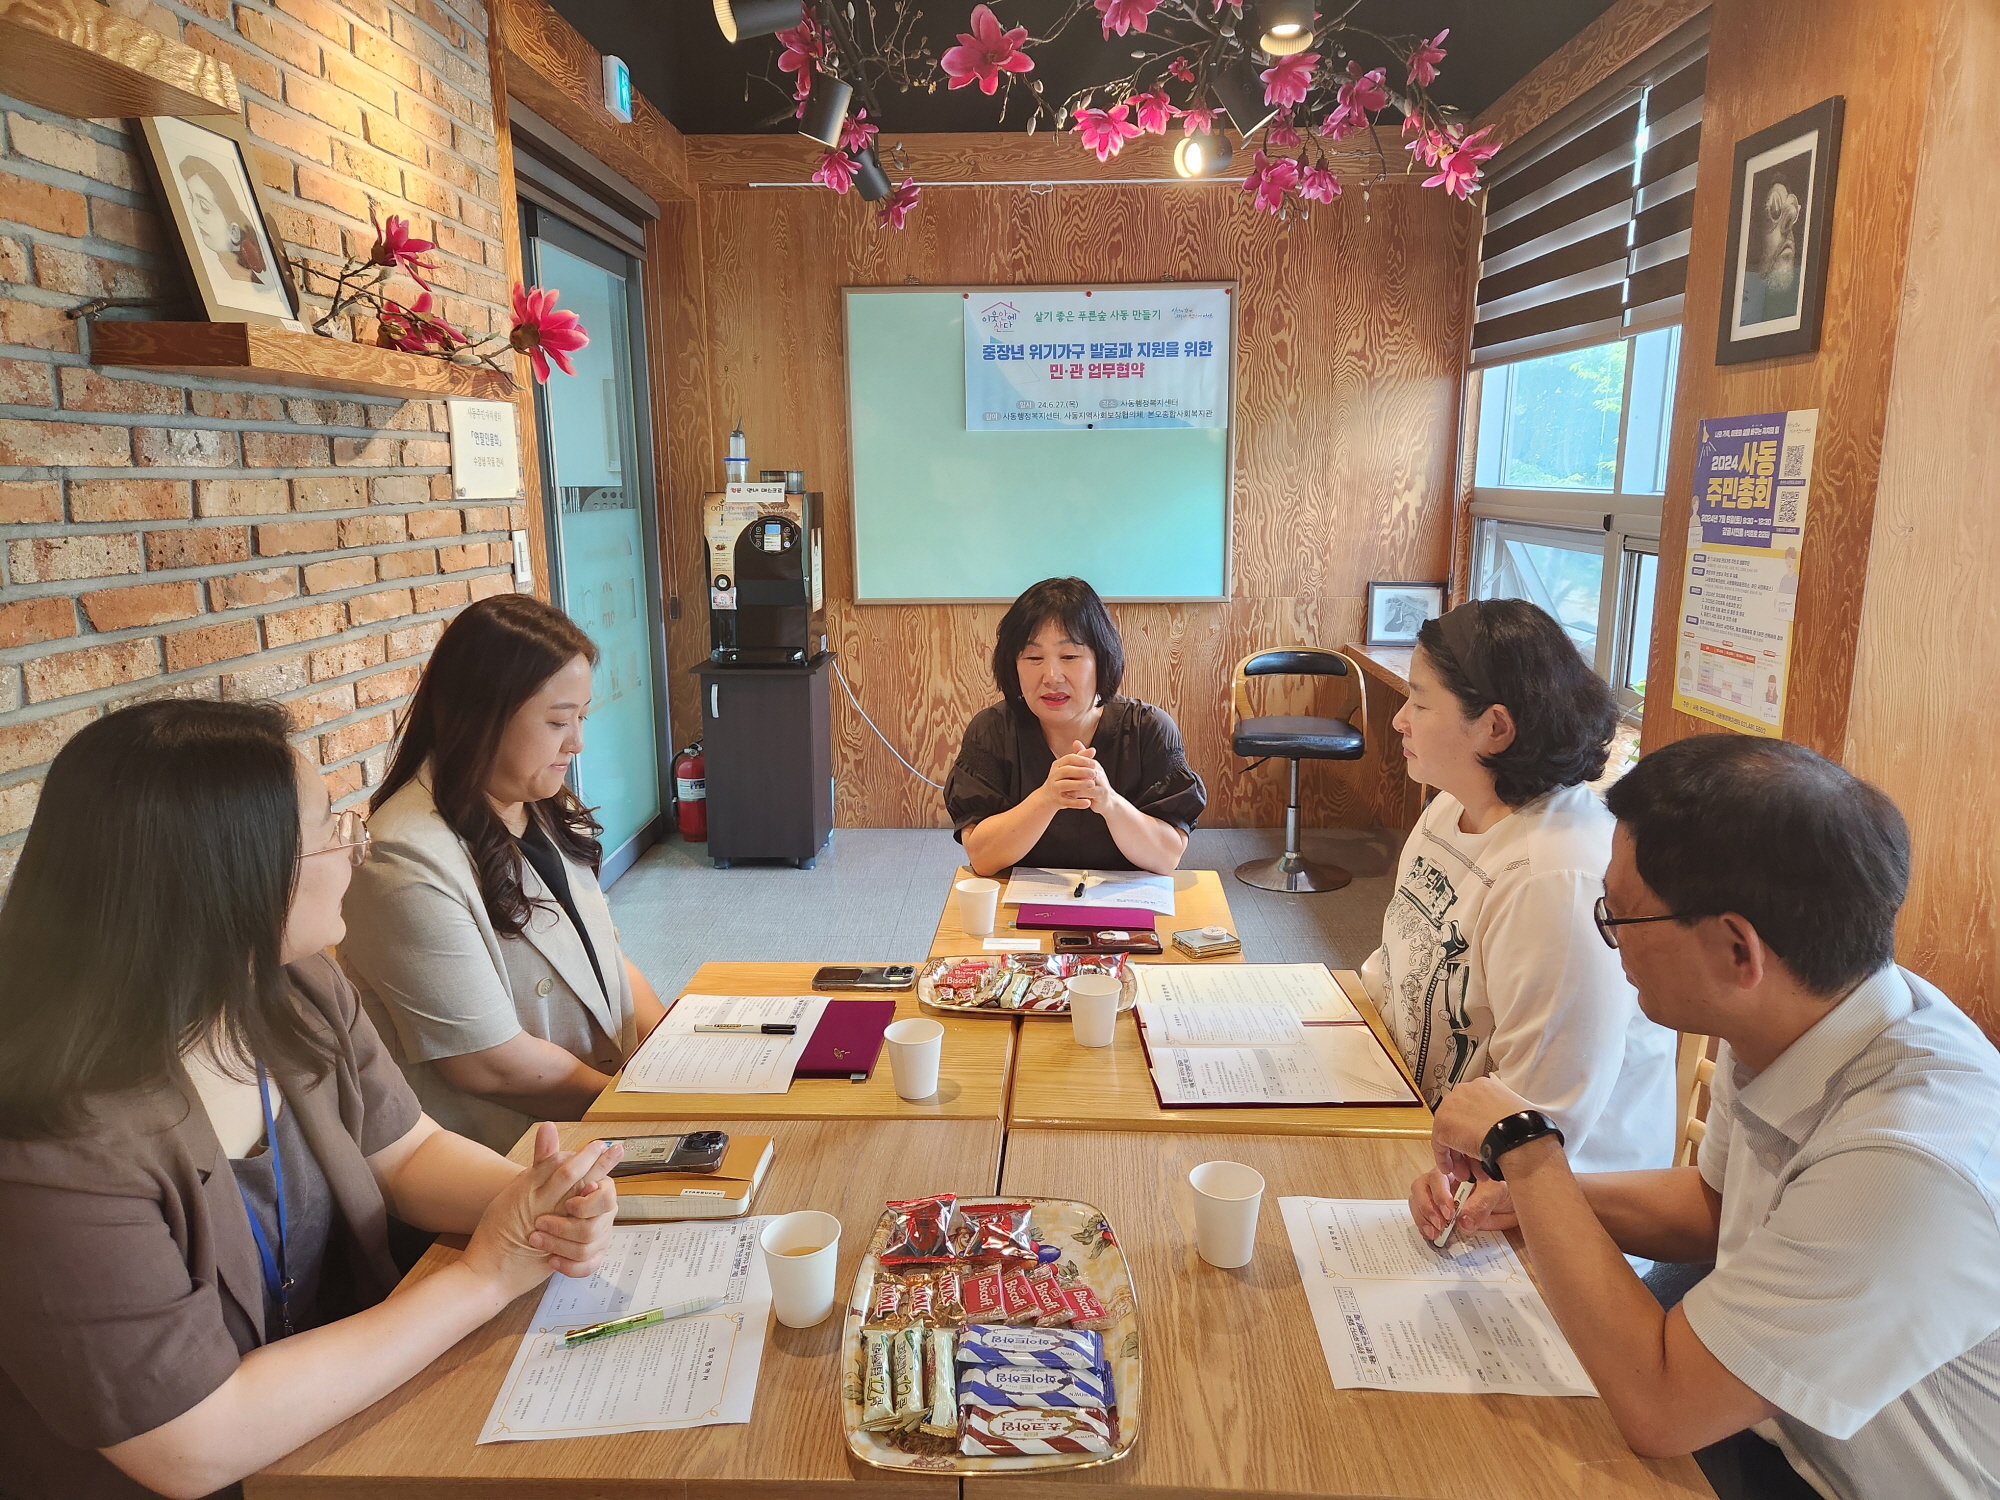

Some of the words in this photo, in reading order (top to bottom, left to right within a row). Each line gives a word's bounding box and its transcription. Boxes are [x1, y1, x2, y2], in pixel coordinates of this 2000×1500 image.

[981, 310, 1017, 323] 이웃안에
[1034, 310, 1053, 322] 살기
[1056, 310, 1075, 322] 좋은
[1077, 309, 1106, 322] 푸른숲
[1110, 309, 1130, 321] 사동
[1132, 308, 1161, 320] 만들기
[993, 321, 1013, 333] 산다
[982, 344, 1025, 360] 중장년
[1029, 343, 1086, 360] 위기가구
[1090, 342, 1133, 359] 발굴과
[1136, 341, 1180, 358] 지원을
[1183, 340, 1213, 357] 위한
[1049, 363, 1084, 380] 민·관
[1088, 362, 1145, 379] 업무협약
[1037, 400, 1079, 409] 24.6.27.(목)
[1120, 399, 1179, 408] 사동행정복지센터
[1147, 410, 1213, 418] 본오종합사회복지관
[1711, 455, 1738, 471] 2024
[1738, 440, 1777, 475] 사동
[1706, 476, 1772, 509] 주민총회
[1701, 514, 1718, 524] 2024년
[947, 976, 973, 985] Biscoff
[941, 1272, 956, 1303] TWIX
[979, 1277, 994, 1308] Biscoff
[1004, 1279, 1027, 1309] Biscoff
[877, 1284, 894, 1316] TWIX
[1035, 1282, 1060, 1312] Biscoff
[1073, 1290, 1099, 1317] Biscoff
[991, 1335, 1051, 1346] 화이트하임
[996, 1373, 1057, 1383] 화이트하임
